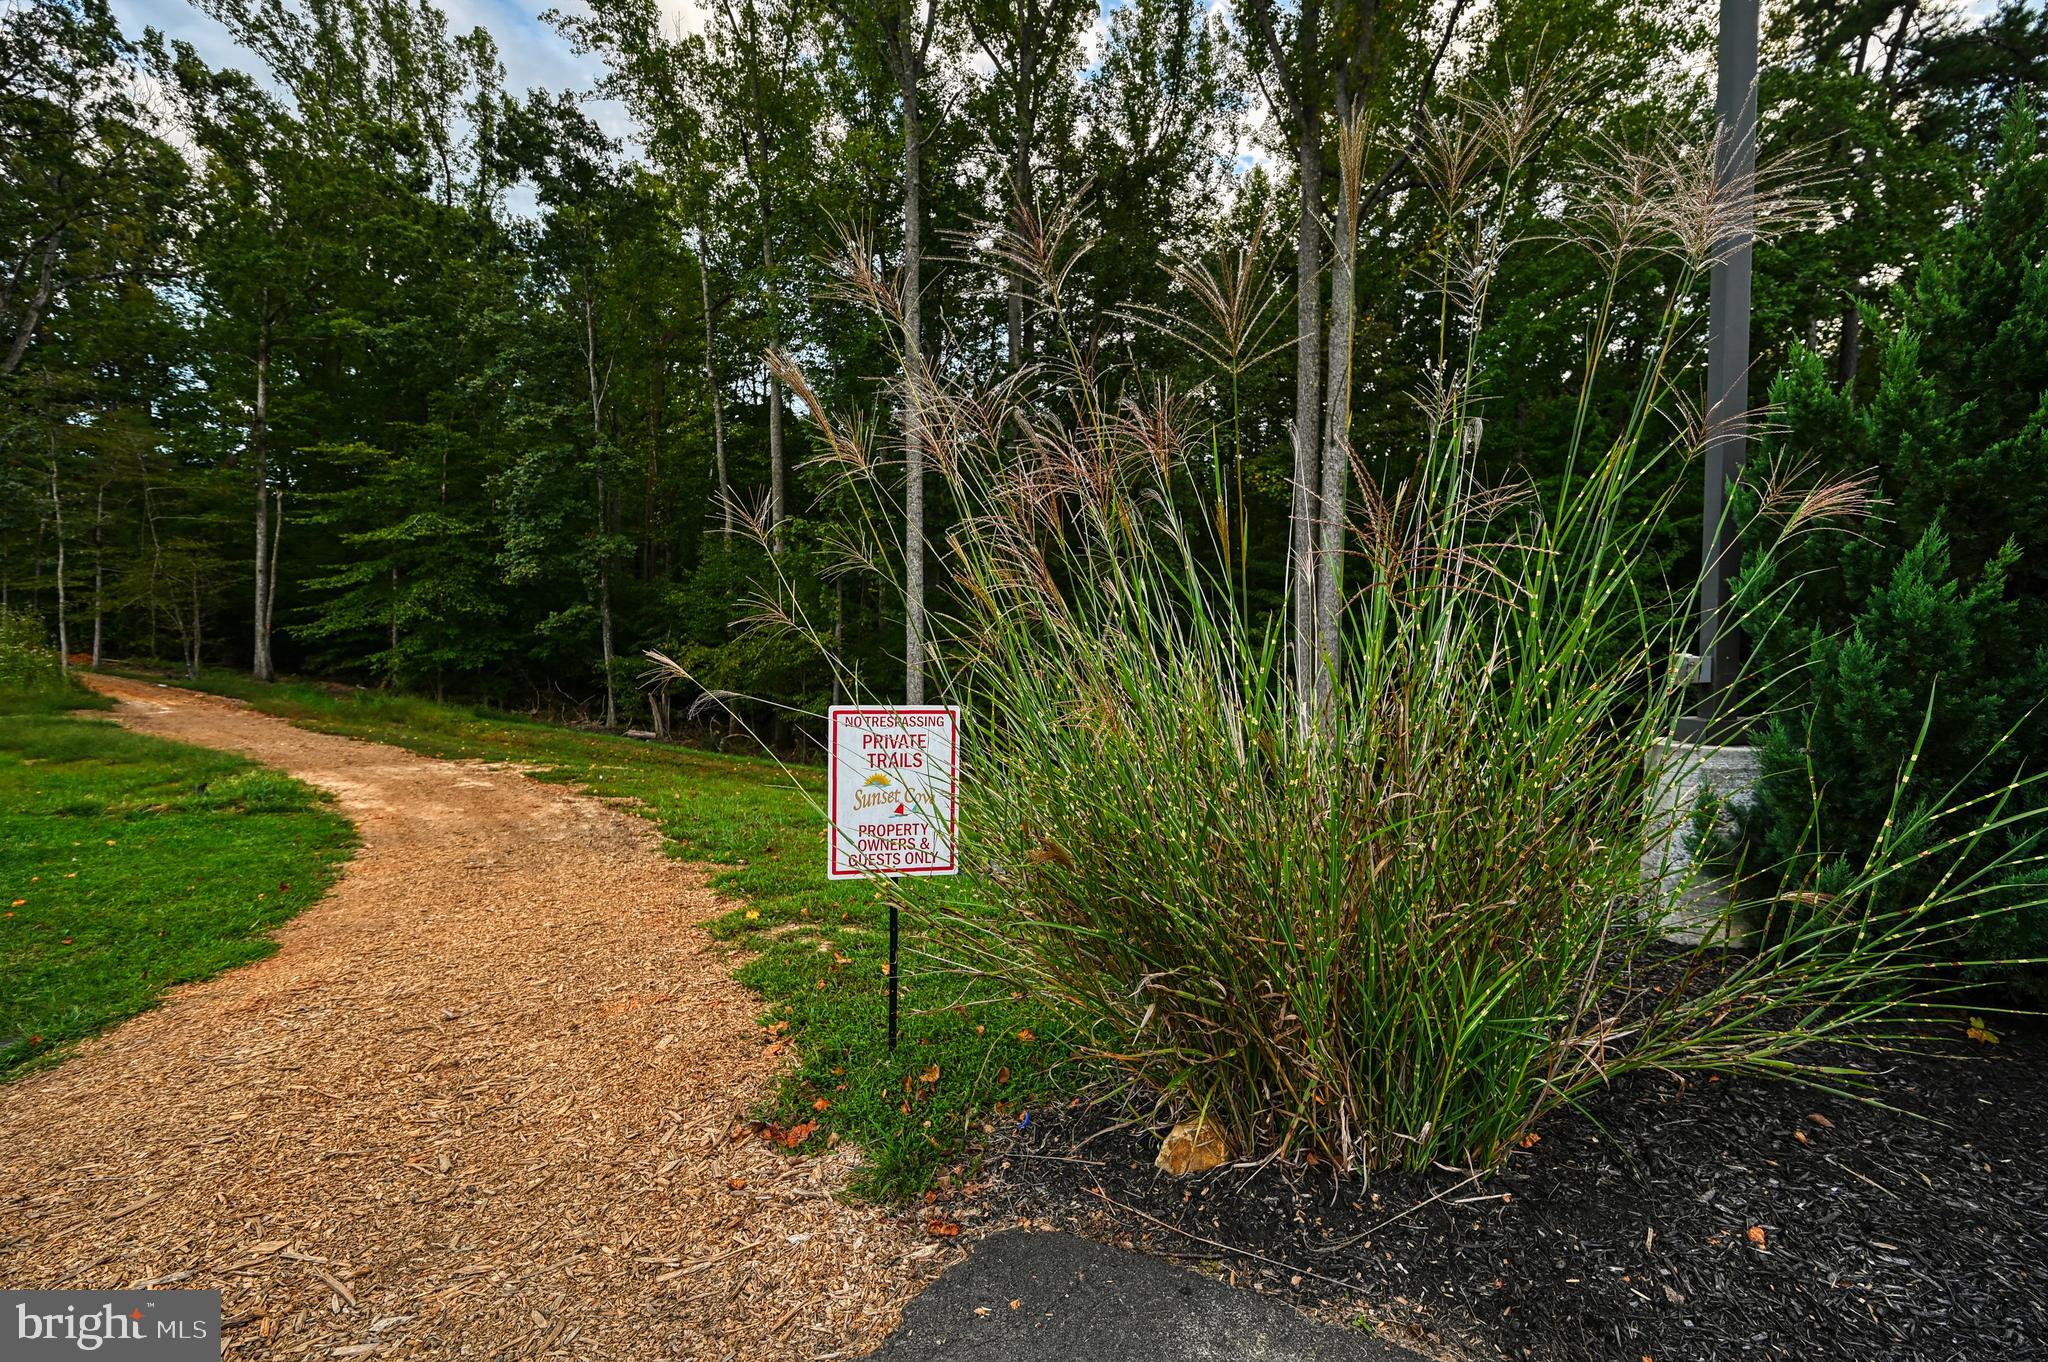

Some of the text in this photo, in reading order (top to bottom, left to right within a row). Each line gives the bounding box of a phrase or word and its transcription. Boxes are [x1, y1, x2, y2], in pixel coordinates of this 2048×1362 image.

[845, 716, 945, 727] NO TRESPASSING
[863, 734, 927, 749] PRIVATE
[867, 752, 923, 768] TRAILS
[853, 788, 936, 811] Sunset Cov
[858, 823, 929, 837] PROPERTY
[858, 838, 930, 852] OWNERS &
[848, 851, 939, 867] GUESTS ONLY
